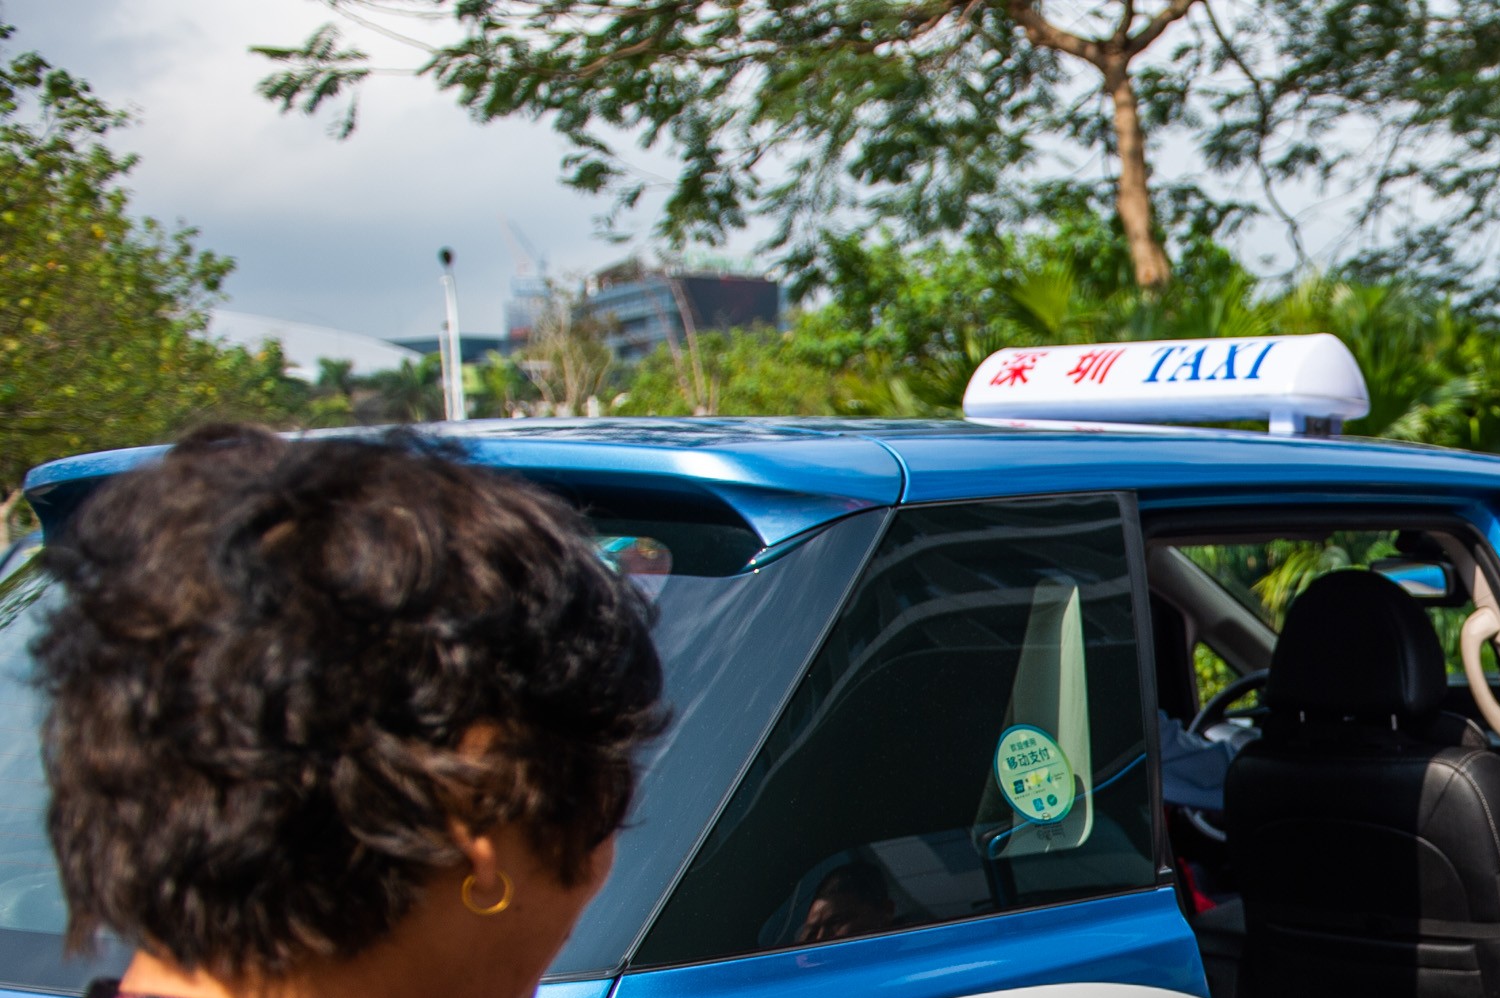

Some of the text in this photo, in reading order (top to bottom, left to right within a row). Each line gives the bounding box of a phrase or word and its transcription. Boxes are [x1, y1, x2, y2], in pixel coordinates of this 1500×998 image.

[990, 342, 1279, 386] 深圳 TAXI
[1007, 747, 1050, 769] 移动支付
